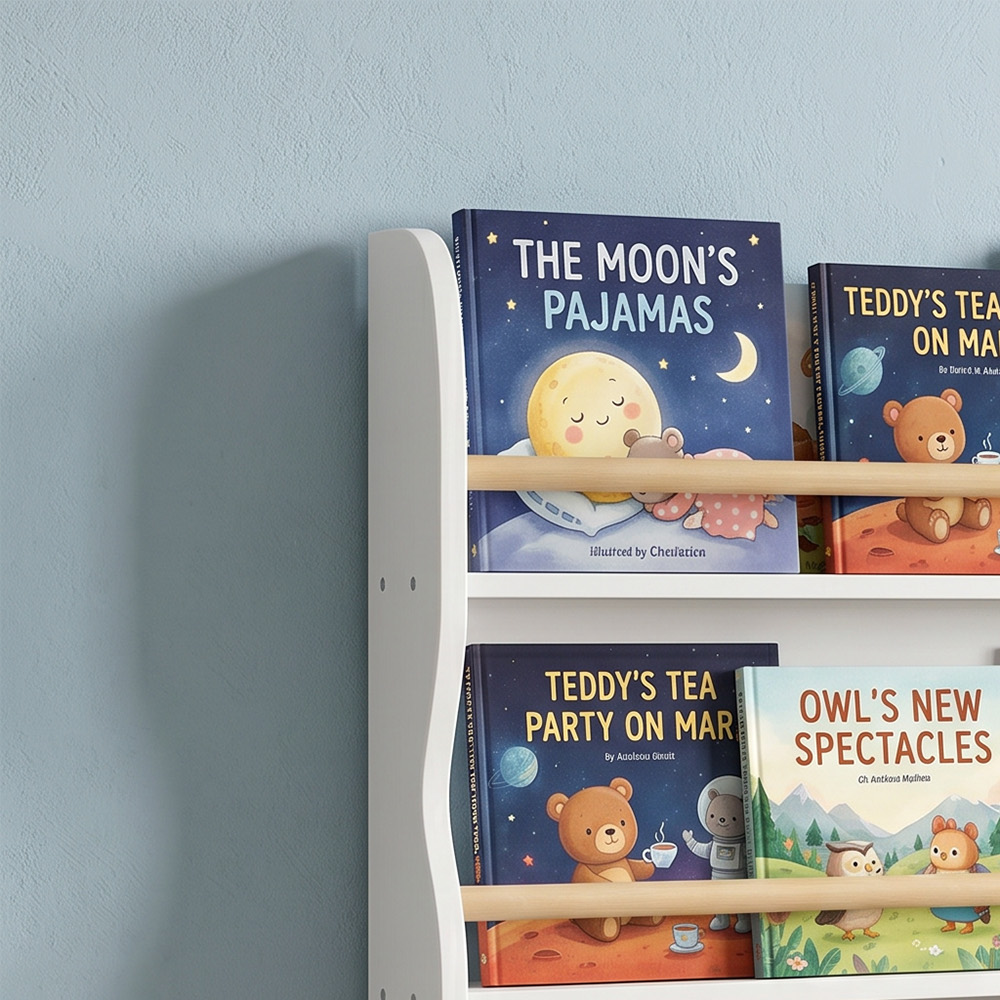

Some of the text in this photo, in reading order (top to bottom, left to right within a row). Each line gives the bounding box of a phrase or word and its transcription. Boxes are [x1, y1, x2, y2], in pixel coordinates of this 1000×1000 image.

[513, 239, 738, 286] THE MOON'S
[544, 290, 714, 334] PAJAMAS
[844, 287, 945, 320] TEDDY'S
[913, 326, 949, 355] ON
[636, 546, 646, 559] by
[545, 670, 717, 701] TEDDY'S TEA
[800, 689, 982, 724] OWL'S NEW
[526, 711, 739, 741] PARTY ON MAR
[605, 752, 615, 763] By
[796, 731, 992, 765] SPECTACLES
